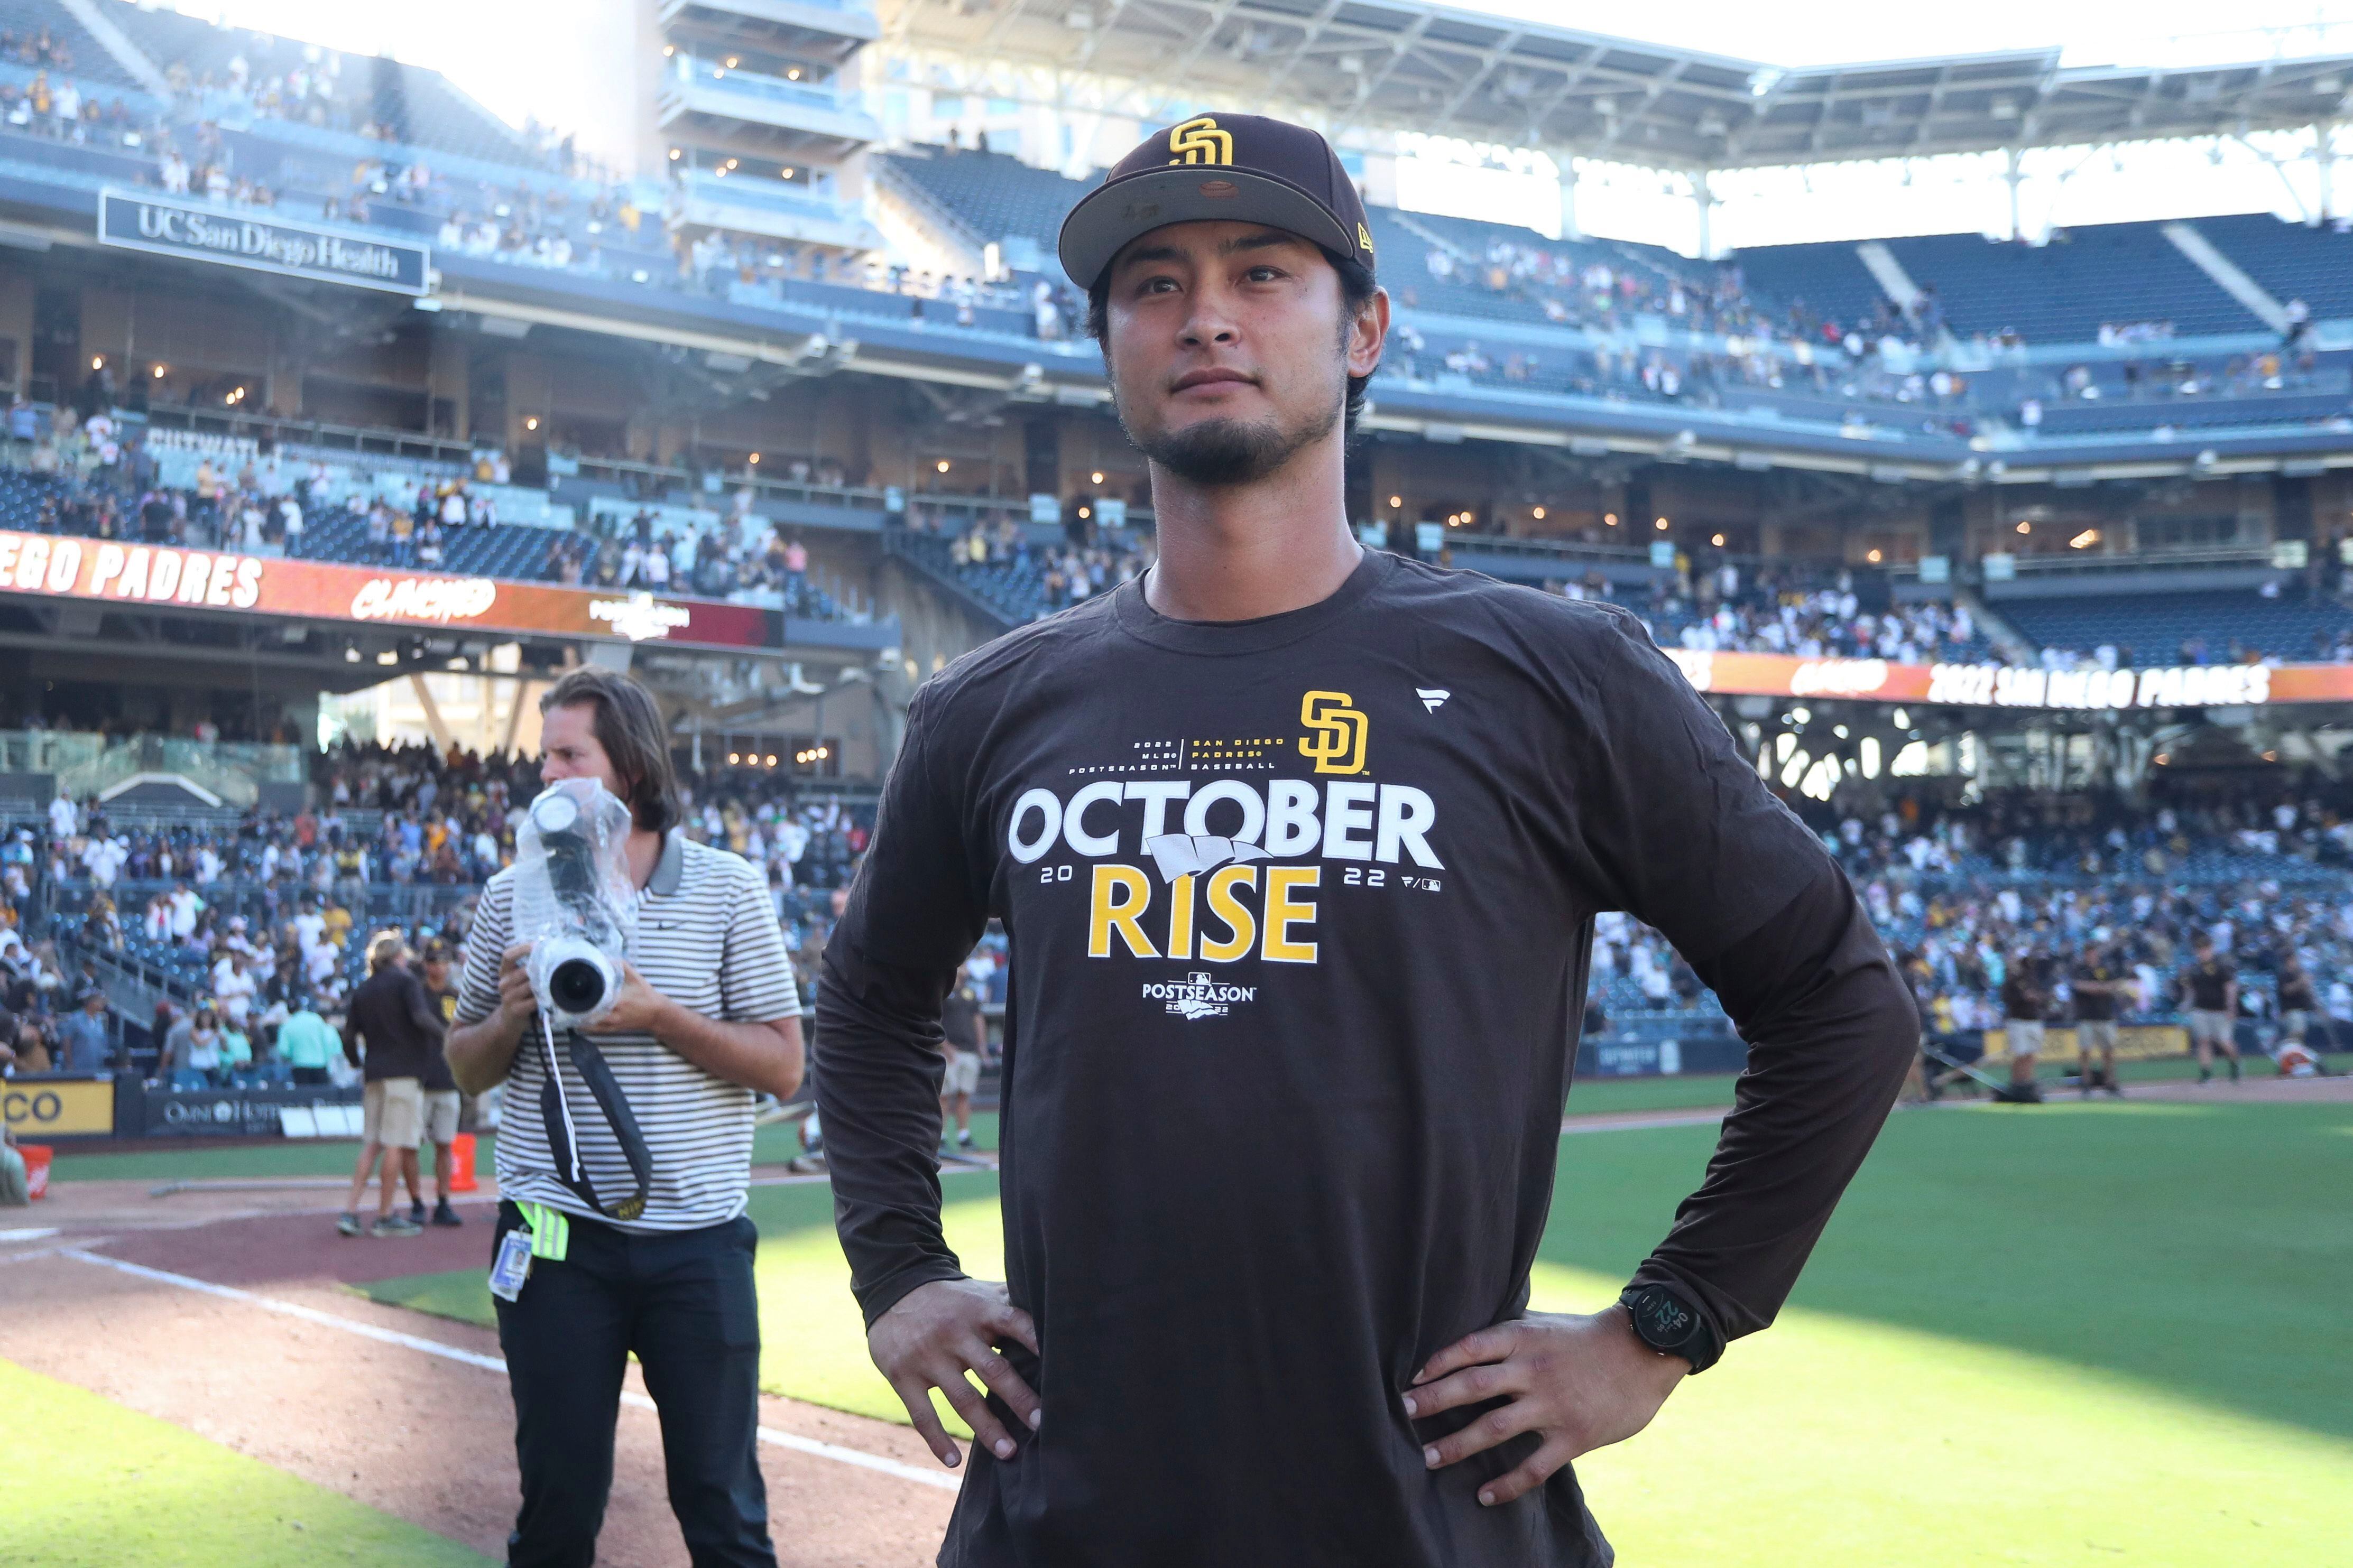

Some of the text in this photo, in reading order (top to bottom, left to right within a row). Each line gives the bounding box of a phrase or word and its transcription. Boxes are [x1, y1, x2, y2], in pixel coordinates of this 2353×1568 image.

[137, 204, 399, 279] UC San Diego Health
[90, 543, 263, 609] PADRES
[2136, 664, 2271, 708] PADRES
[1191, 762, 1275, 771] BASEBALL
[1008, 780, 1445, 871] OCTOBER
[1040, 867, 1073, 884] 20
[1343, 868, 1386, 887] 22
[1087, 864, 1321, 964] RISE
[1142, 984, 1254, 1001] POSTSEASON
[1654, 1300, 1679, 1324] 22
